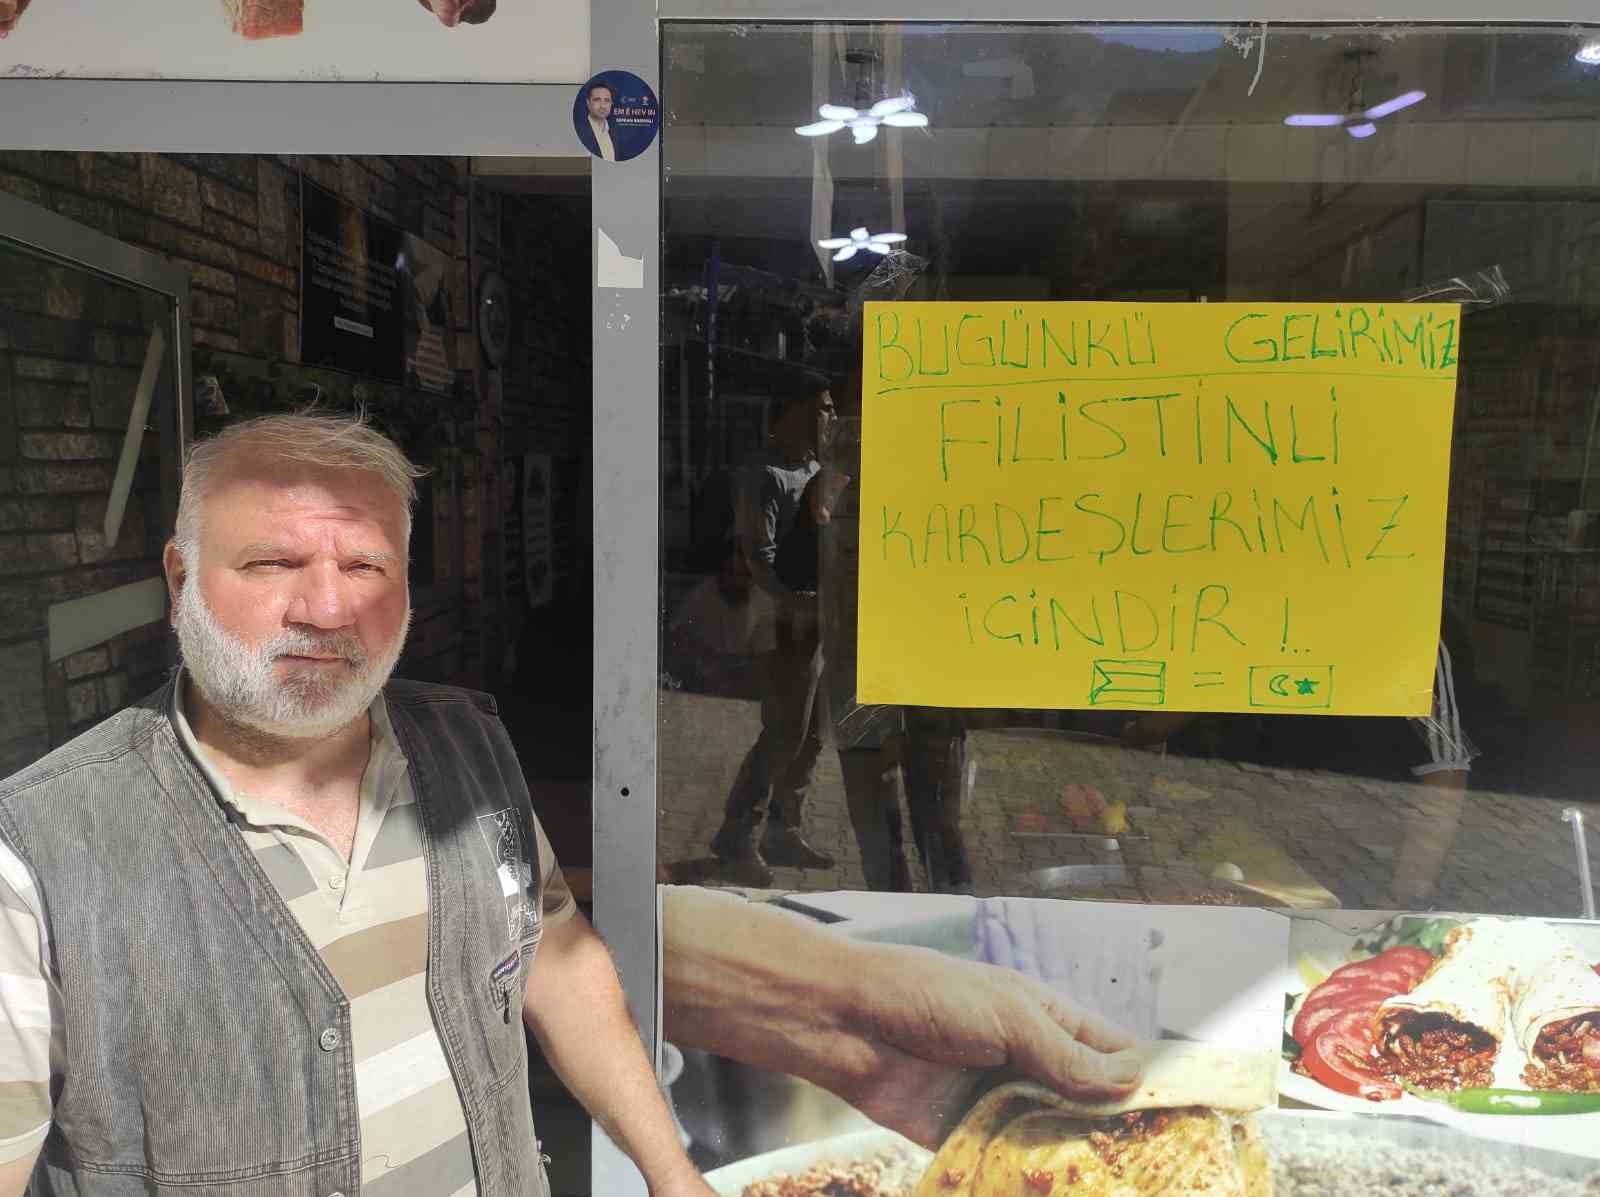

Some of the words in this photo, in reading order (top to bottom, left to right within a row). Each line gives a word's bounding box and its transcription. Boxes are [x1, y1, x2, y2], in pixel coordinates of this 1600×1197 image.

[877, 308, 1156, 382] BUGÜNKÜ
[1224, 305, 1457, 369] GELİRİMİZ
[940, 379, 1339, 481] FİLİSTİNLİ
[881, 486, 1415, 568] KARDEŞLERİMİZ
